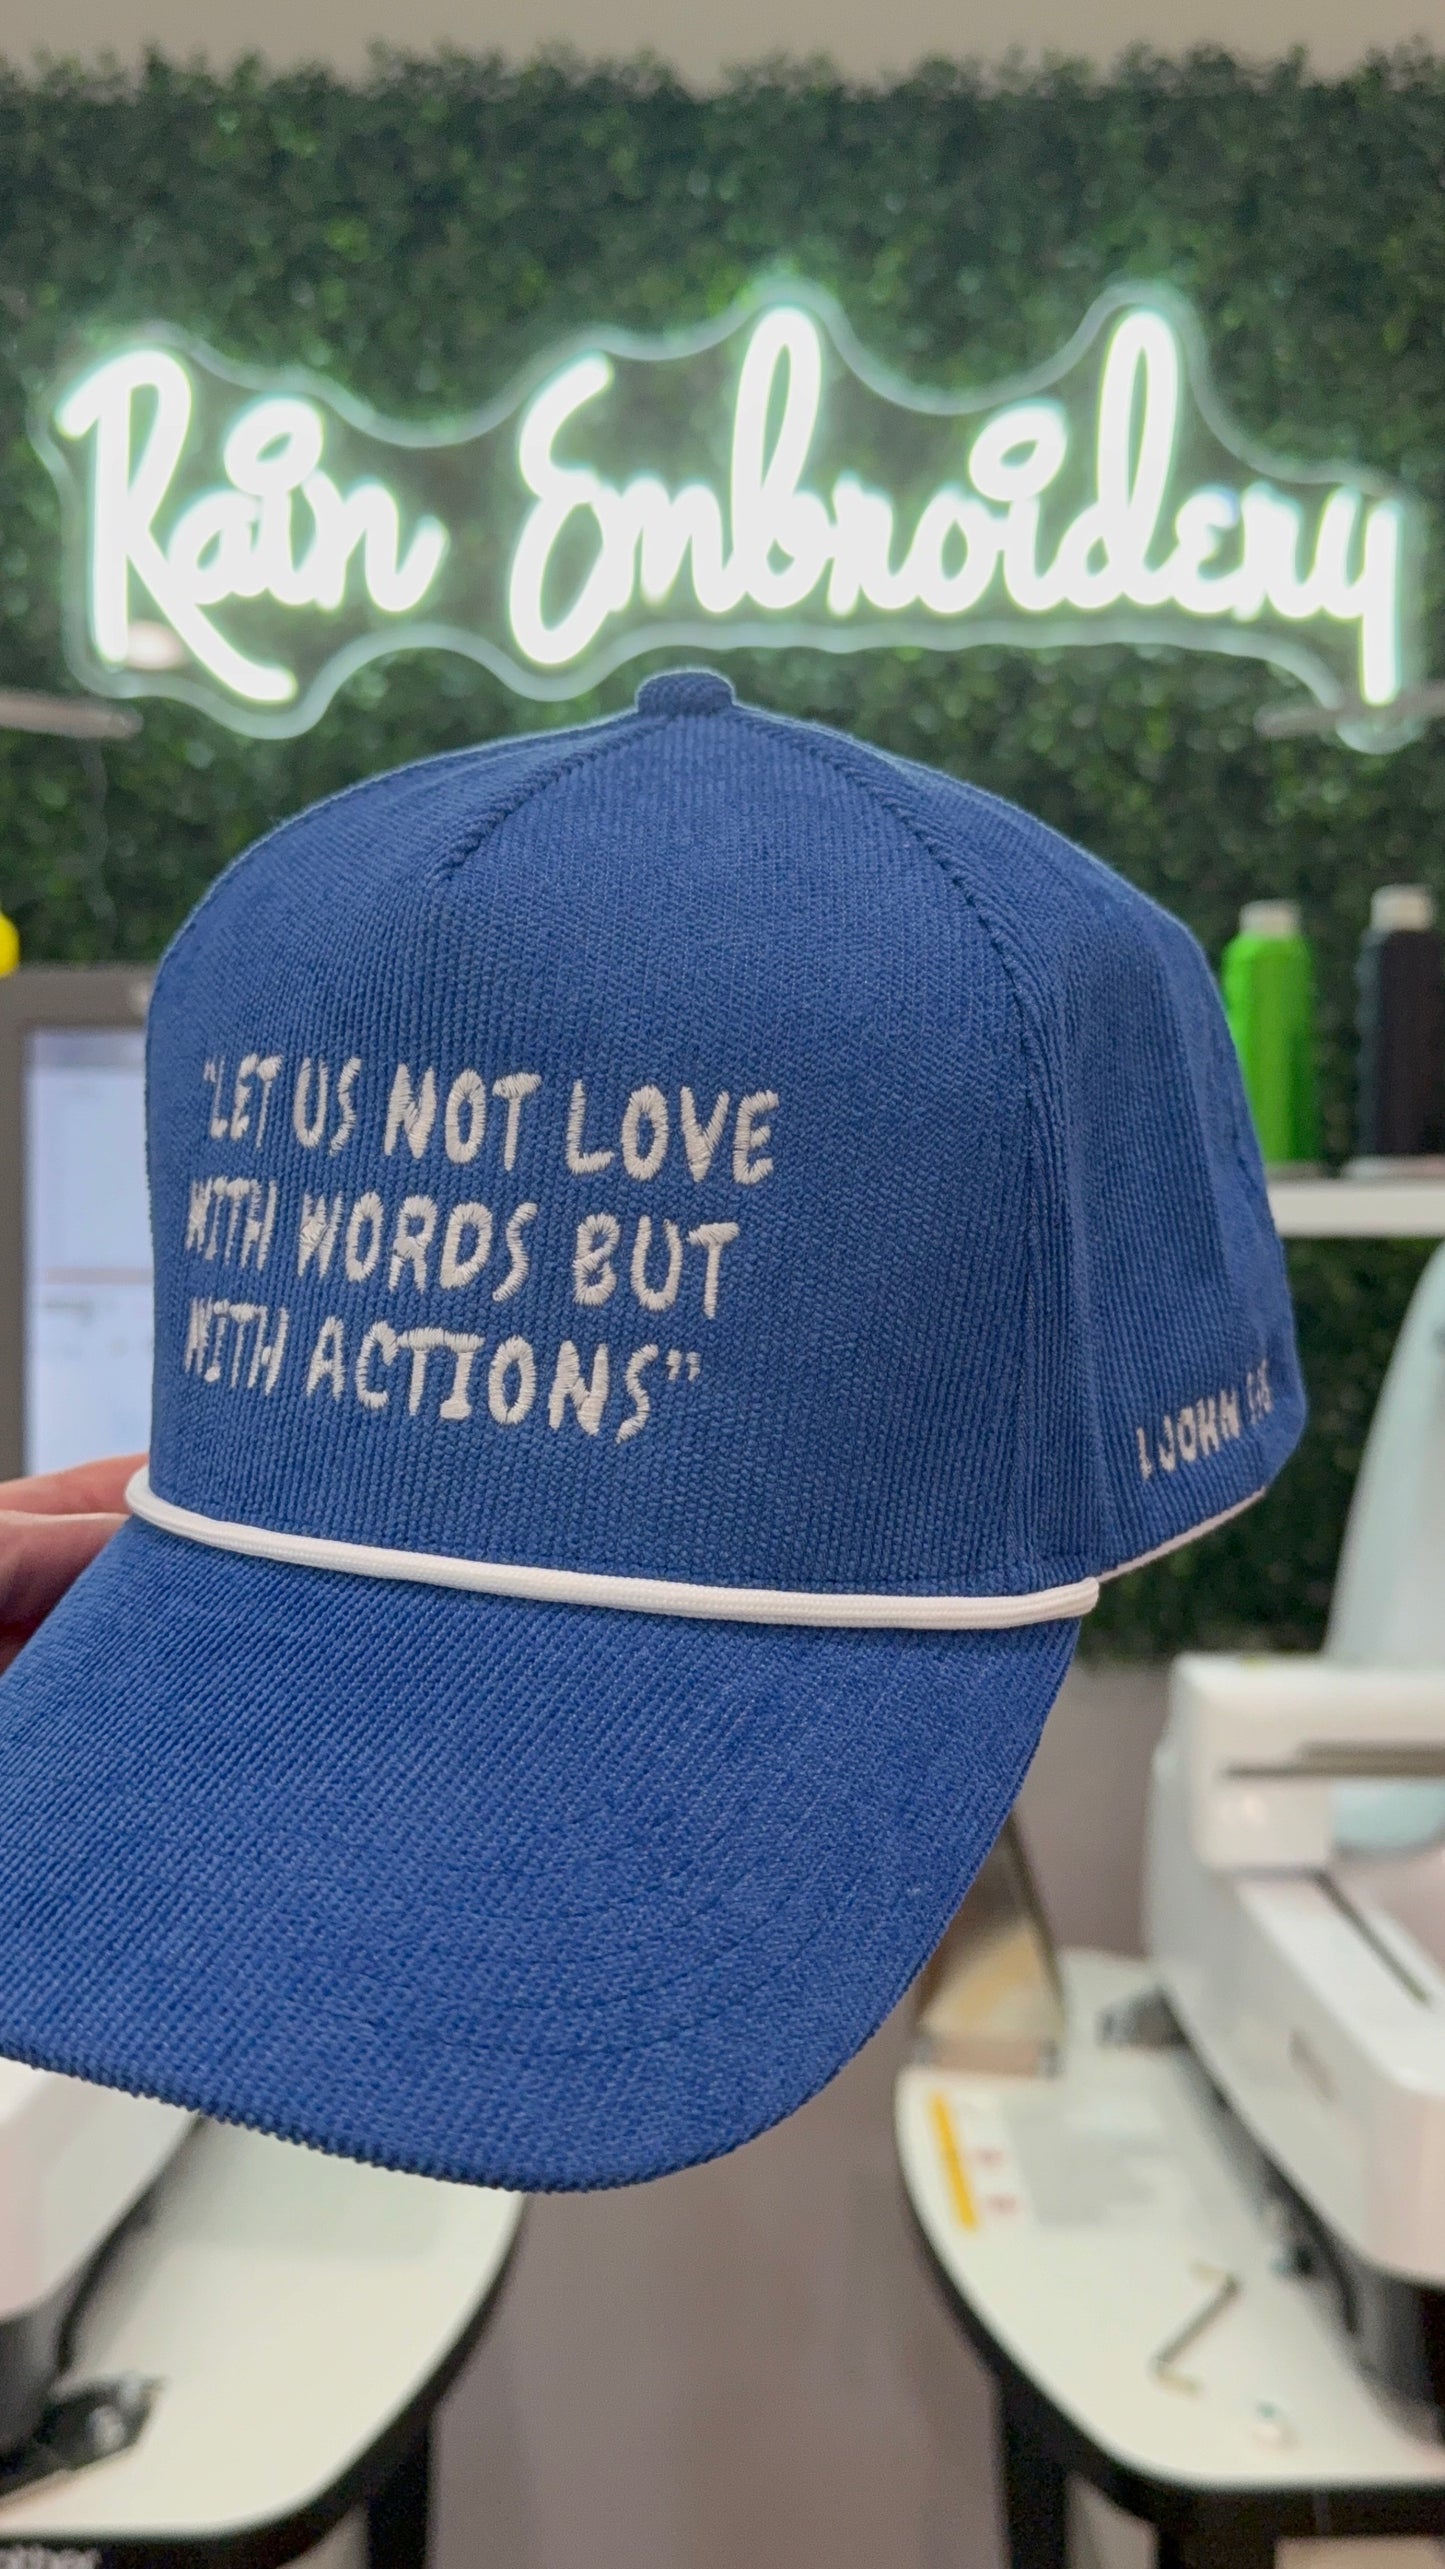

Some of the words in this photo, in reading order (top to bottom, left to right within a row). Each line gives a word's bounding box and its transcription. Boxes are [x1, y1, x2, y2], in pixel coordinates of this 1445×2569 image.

[56, 346, 450, 703] Rain
[508, 306, 1402, 706] Embroidery
[293, 1056, 362, 1158] US
[384, 1063, 542, 1172] NOT
[565, 1079, 779, 1186] LOVE
[184, 1175, 279, 1272] WITH
[297, 1191, 538, 1303] WORDS
[571, 1211, 740, 1321] BUT
[184, 1296, 291, 1397] WITH
[1158, 1388, 1241, 1473] JOHN
